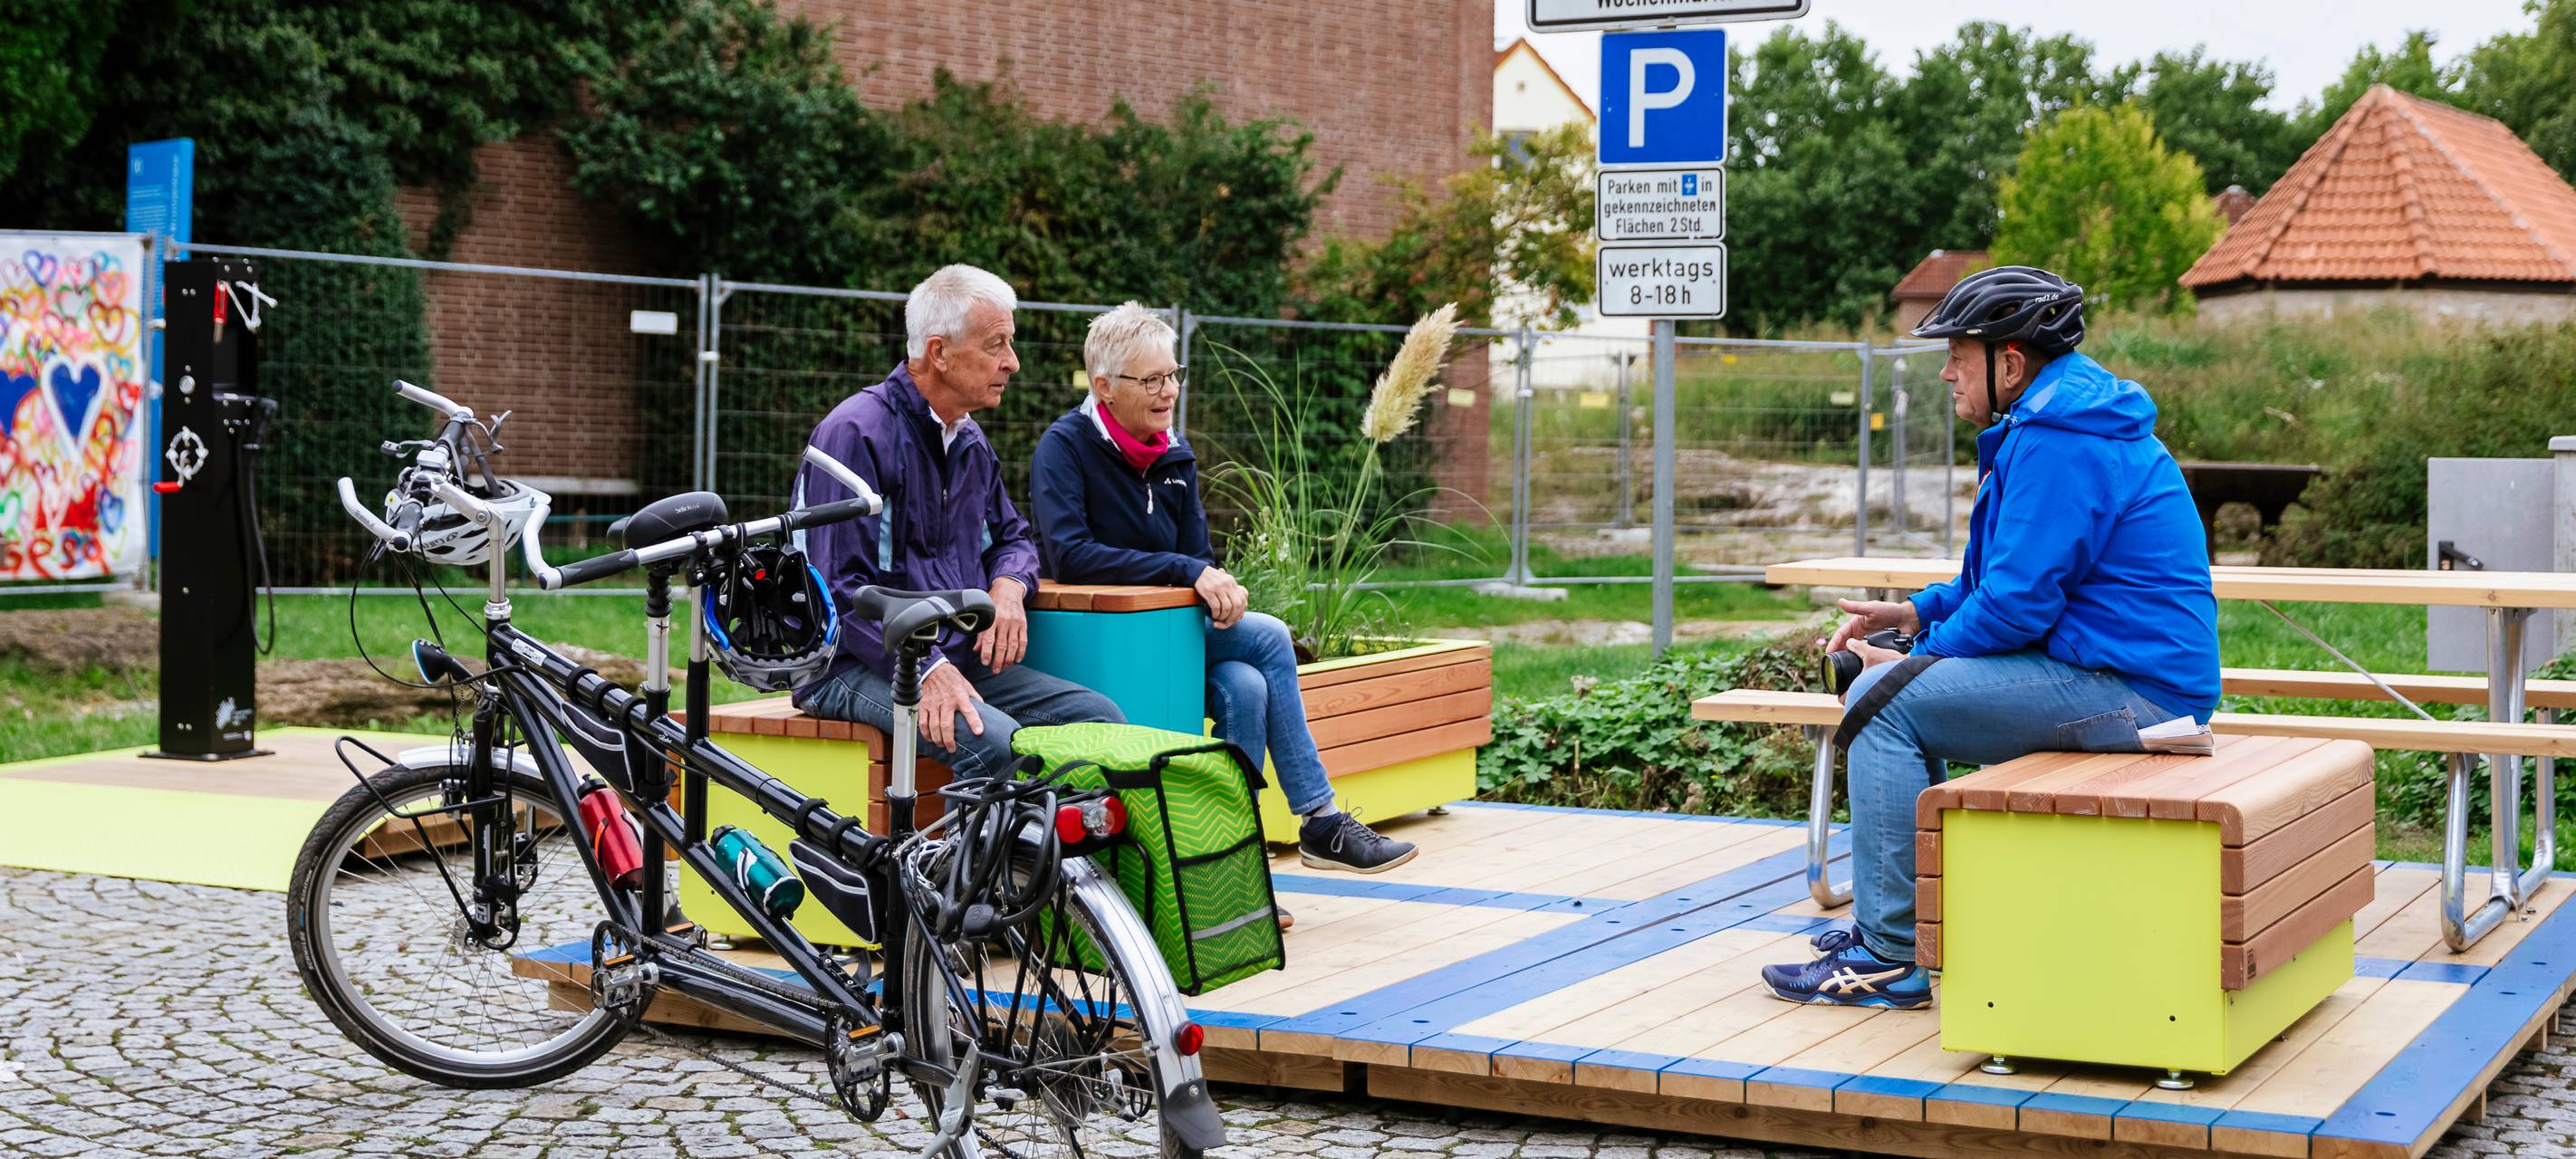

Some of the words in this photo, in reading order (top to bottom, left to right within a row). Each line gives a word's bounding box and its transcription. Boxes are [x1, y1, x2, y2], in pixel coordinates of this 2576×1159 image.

[1629, 47, 1695, 148] P
[1608, 178, 1650, 194] Parken
[1657, 177, 1677, 193] mit
[1701, 177, 1712, 192] in
[1604, 197, 1716, 218] gekennzeichneten
[1616, 217, 1664, 234] Flächen
[1670, 217, 1677, 233] 2
[1680, 217, 1705, 233] Std.
[1609, 257, 1714, 283] werktags
[1630, 284, 1676, 305] 8-18
[1682, 284, 1690, 304] h
